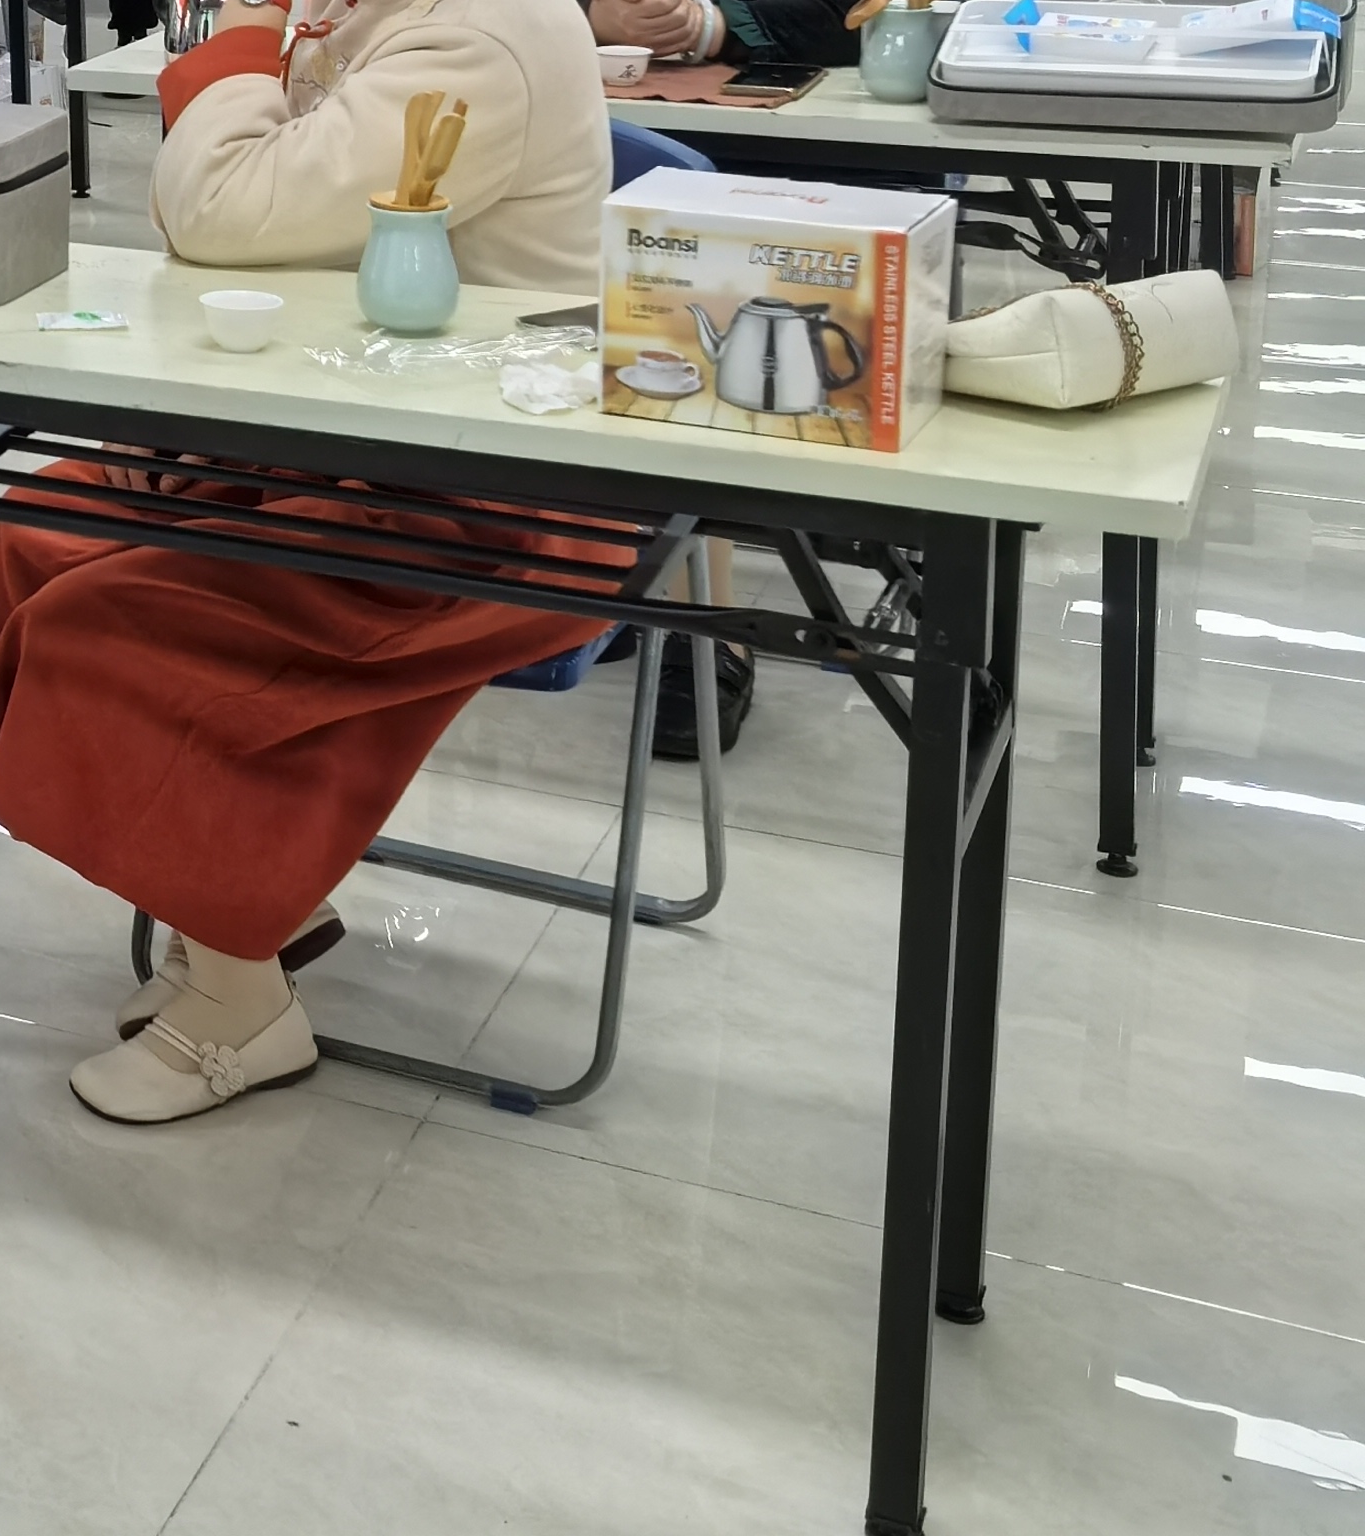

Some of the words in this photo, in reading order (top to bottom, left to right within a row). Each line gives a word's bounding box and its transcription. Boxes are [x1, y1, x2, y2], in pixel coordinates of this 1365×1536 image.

[628, 228, 699, 252] Boansi
[748, 243, 861, 273] KETTLE
[883, 244, 900, 322] STAINLESS
[882, 325, 898, 369] STEEL
[880, 371, 897, 426] KETTLE
